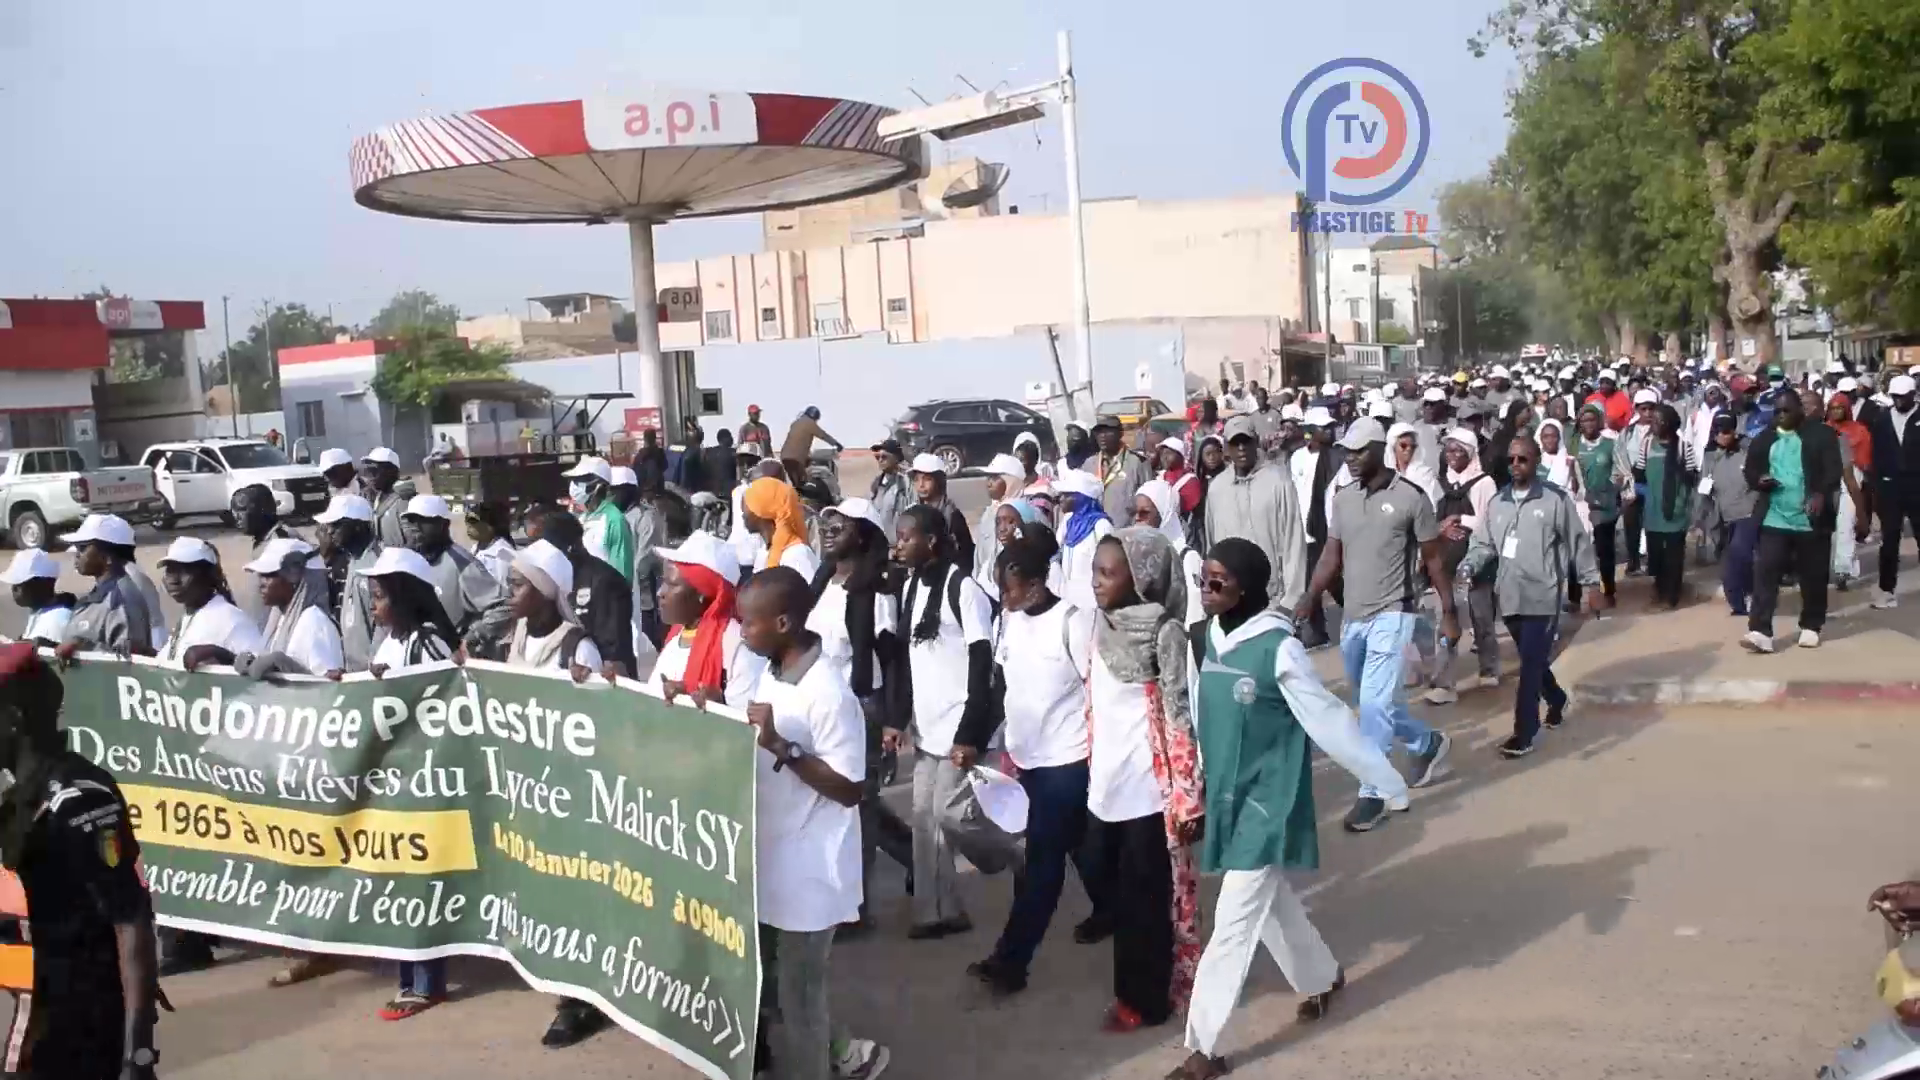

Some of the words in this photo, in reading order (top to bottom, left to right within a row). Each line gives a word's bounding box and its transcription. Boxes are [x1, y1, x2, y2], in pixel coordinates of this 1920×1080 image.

[624, 94, 720, 144] a.p.i
[117, 676, 362, 749] Randonnée
[68, 726, 141, 772] Des
[410, 749, 468, 797] du
[480, 746, 572, 820] Lycée
[584, 769, 689, 860] Malick
[696, 809, 743, 886] SY
[155, 799, 231, 840] 1965
[238, 811, 260, 845] à
[266, 822, 325, 857] nos
[266, 879, 344, 925] pour
[520, 914, 597, 964] nous
[602, 945, 616, 977] a
[525, 838, 611, 885] Janvier
[612, 860, 654, 908] 2026
[673, 890, 686, 924] à
[689, 898, 746, 958] 09h00
